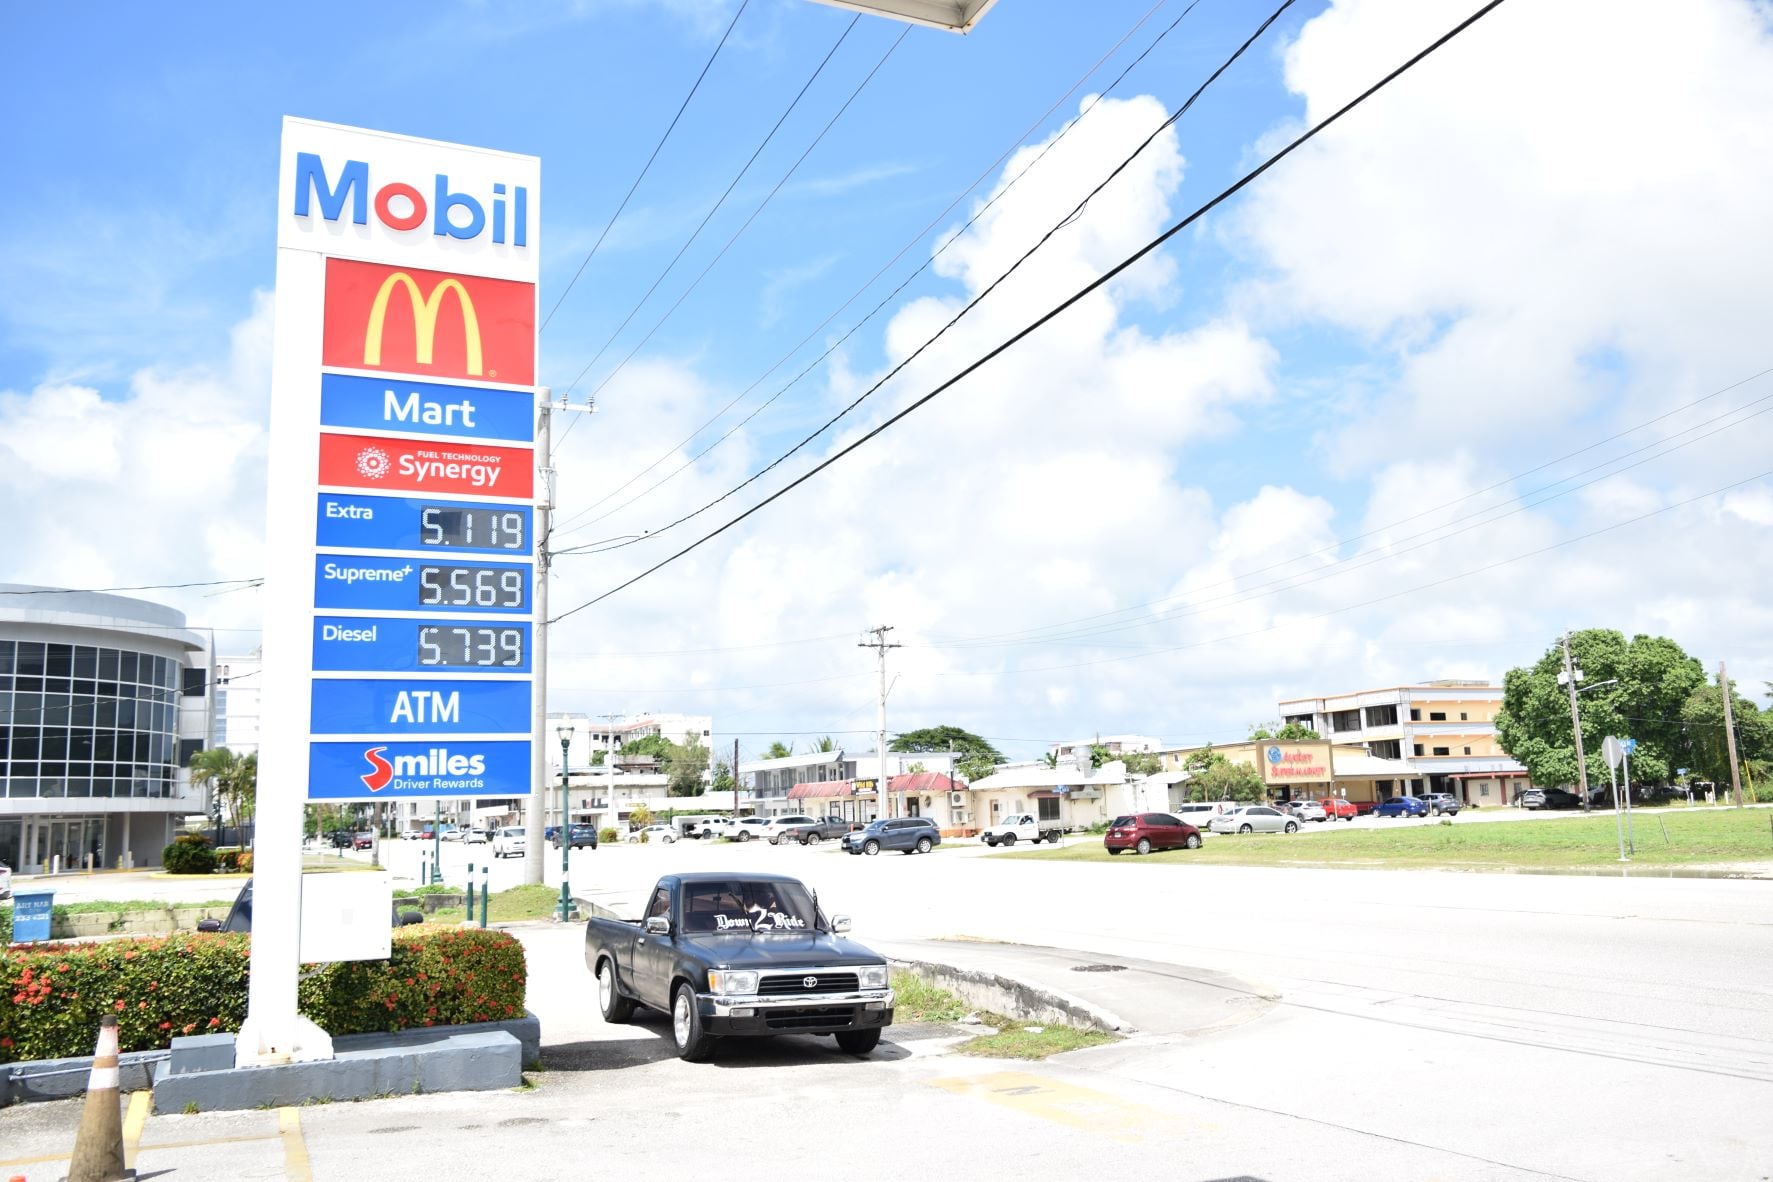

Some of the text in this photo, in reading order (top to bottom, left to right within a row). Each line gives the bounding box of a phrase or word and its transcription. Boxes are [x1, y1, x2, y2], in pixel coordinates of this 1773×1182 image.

[294, 152, 527, 247] Mobil
[383, 390, 476, 428] Mart
[398, 455, 502, 487] Synergy
[417, 450, 502, 464] FUEL TECHNOLOGY
[326, 502, 373, 520] Extra
[422, 508, 522, 549] 5.119
[421, 567, 522, 607] 5.569
[322, 625, 377, 642] Diesel
[419, 628, 521, 666] 5.739
[390, 691, 460, 723] ATM
[360, 746, 486, 793] Smiles
[393, 778, 484, 790] Driver Rewards
[749, 904, 774, 930] 2
[767, 912, 806, 930] Ride
